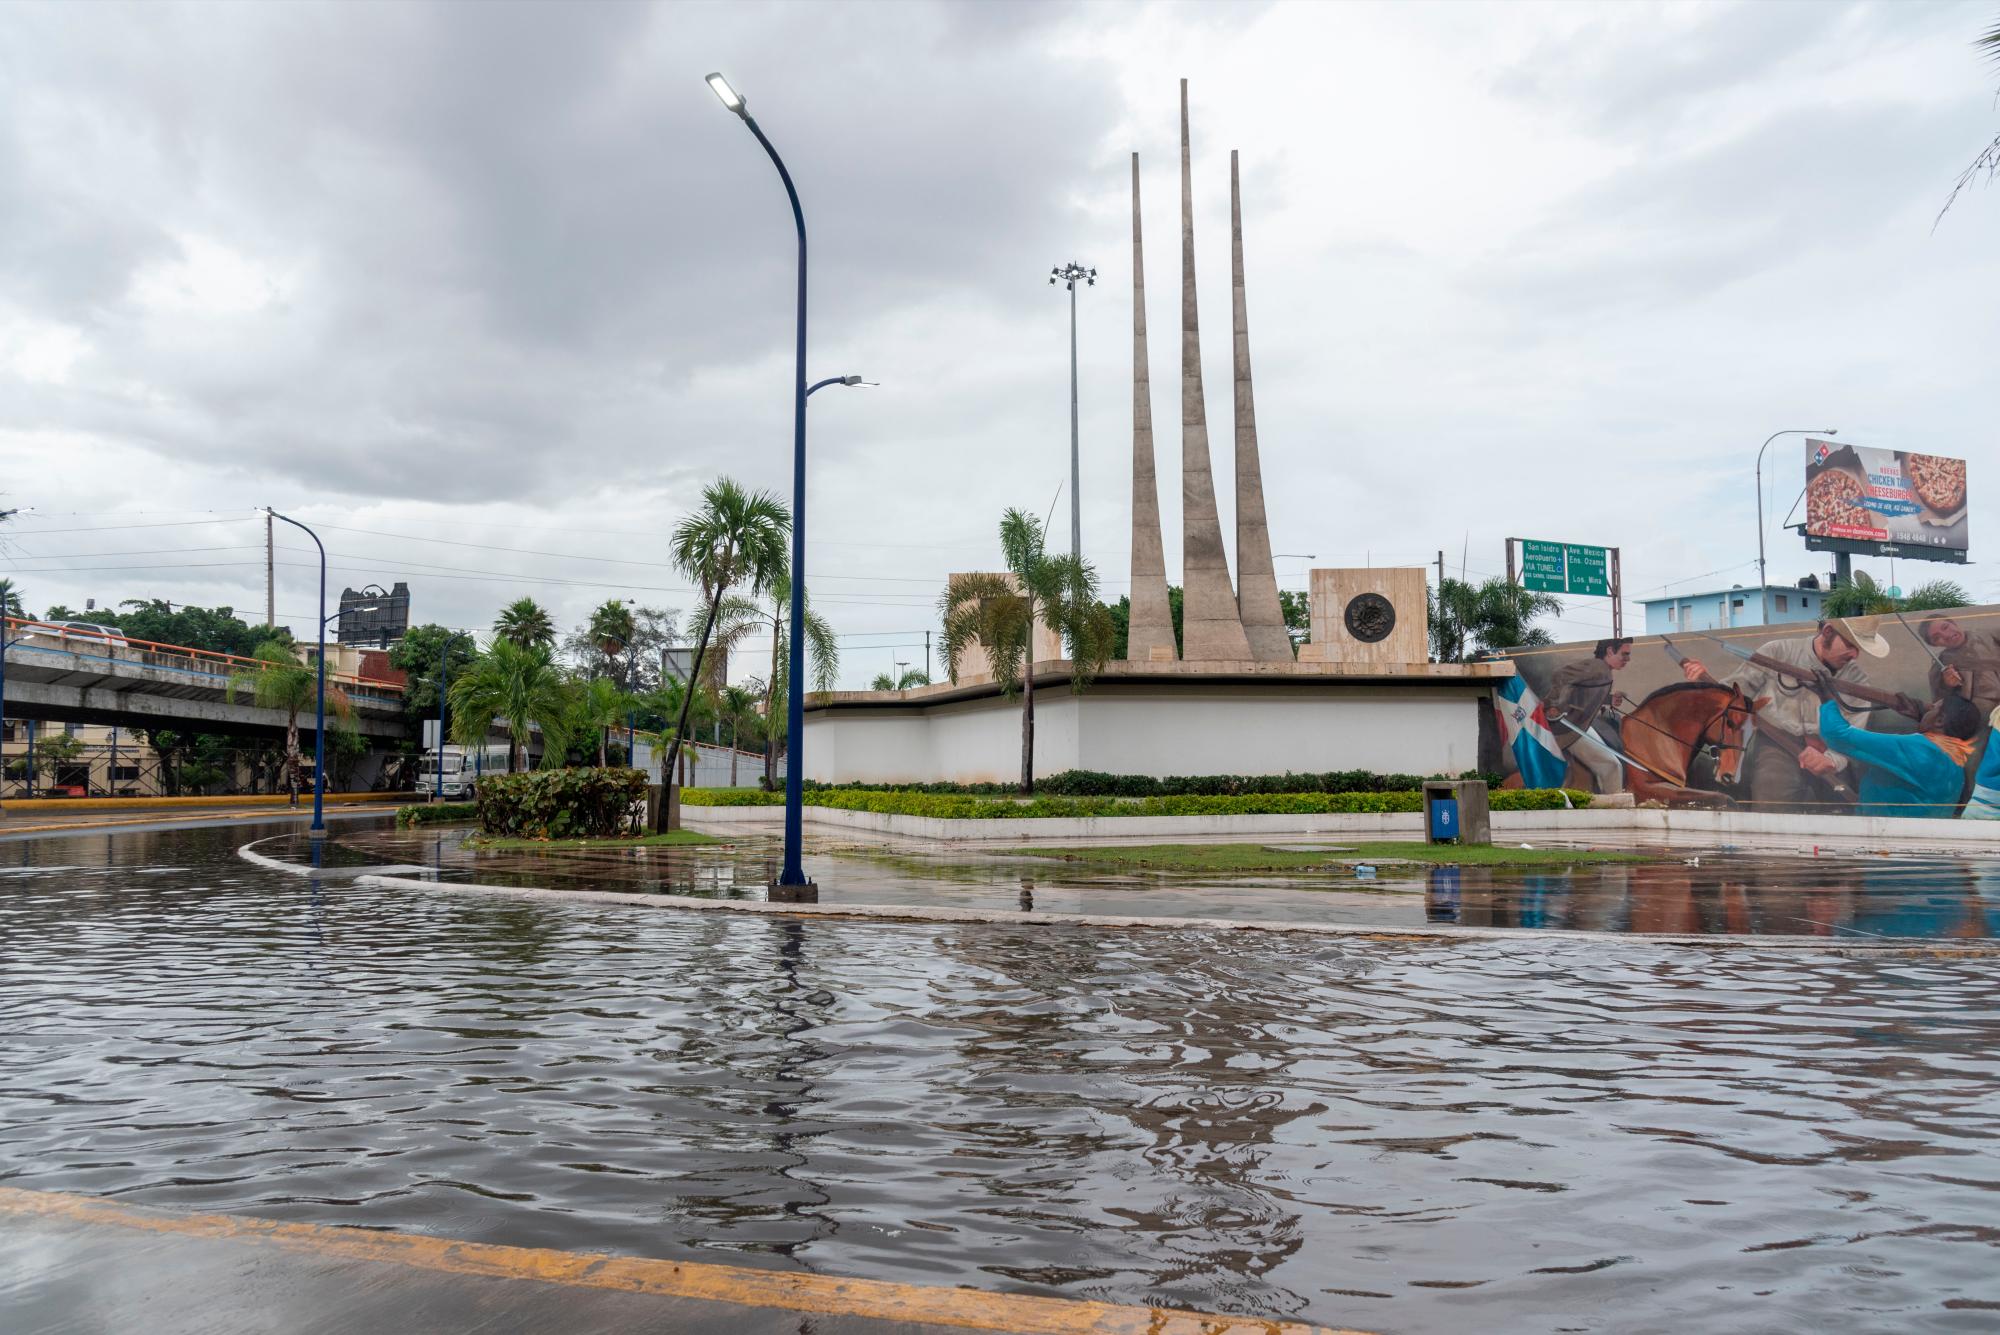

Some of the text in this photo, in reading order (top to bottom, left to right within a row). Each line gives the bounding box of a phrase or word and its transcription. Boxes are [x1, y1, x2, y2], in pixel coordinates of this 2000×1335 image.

[1868, 473, 1895, 487] CHICKEN
[1541, 544, 1559, 553] Isidro
[1569, 546, 1581, 555] Ave.
[1526, 553, 1557, 562] Aeropuerto
[1584, 557, 1603, 566] Ozama
[1573, 574, 1584, 582] Los
